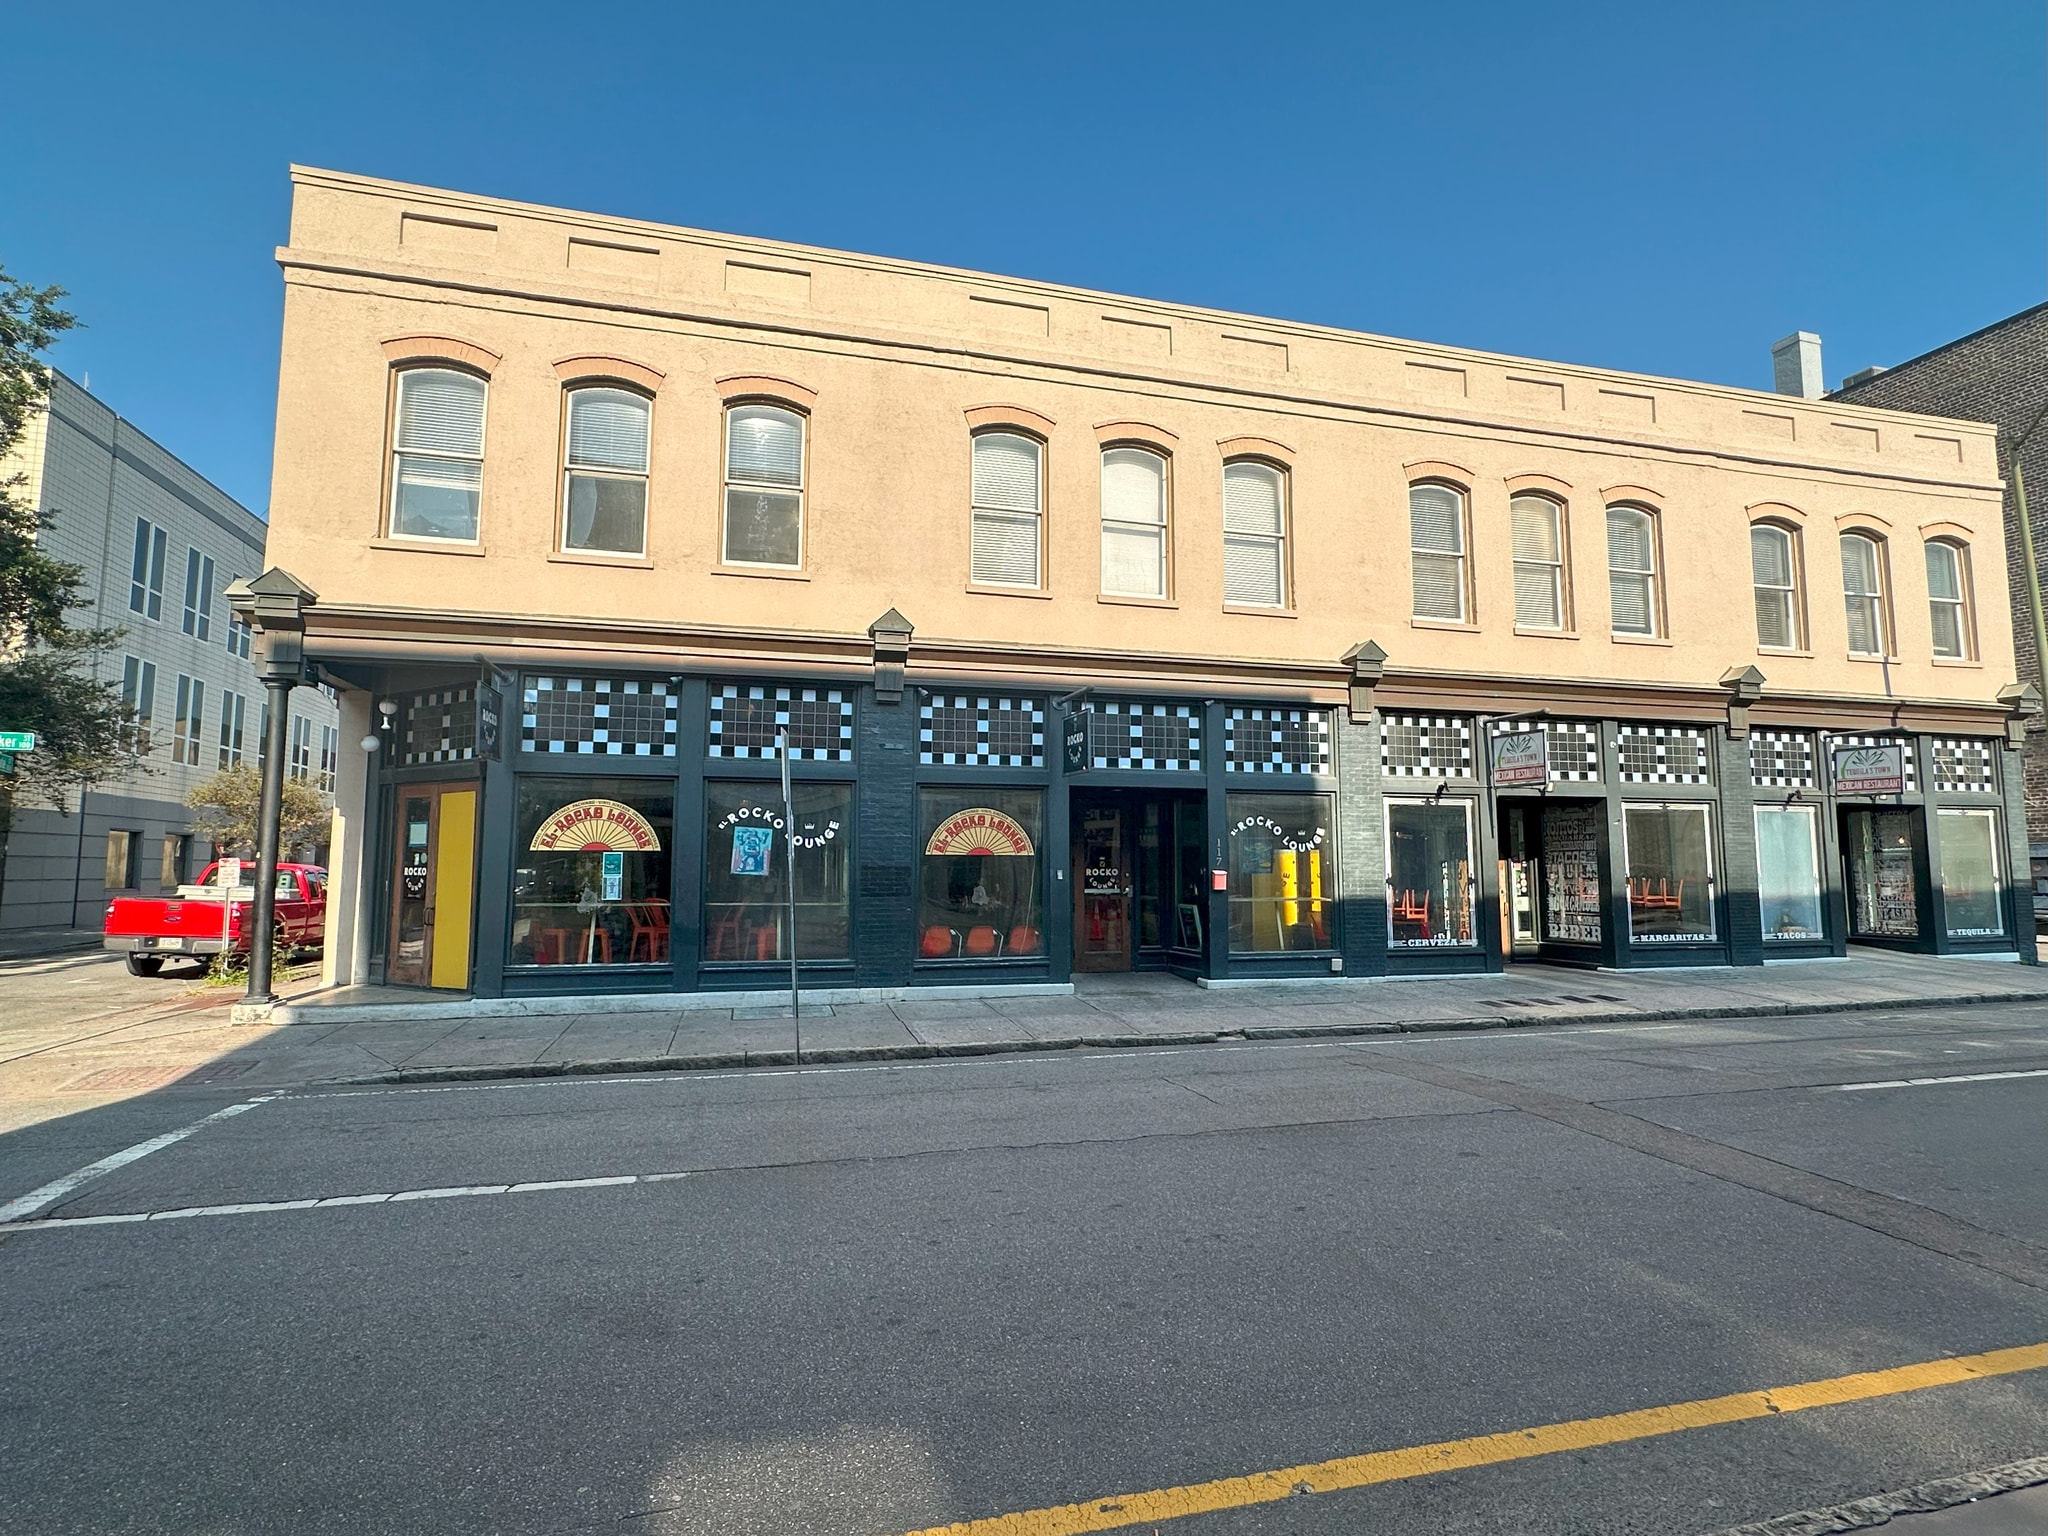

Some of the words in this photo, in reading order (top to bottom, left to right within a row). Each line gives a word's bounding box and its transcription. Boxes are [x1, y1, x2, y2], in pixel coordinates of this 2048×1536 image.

[1874, 766, 1891, 774] TOWN
[1837, 780, 1862, 791] MEXICAN
[1863, 778, 1901, 790] RESTAURANT
[718, 820, 728, 830] EL
[726, 807, 784, 829] ROCKO
[1237, 816, 1282, 836] ROCKO
[1551, 850, 1587, 863] TACOS
[403, 867, 427, 876] ROCKO
[1085, 868, 1119, 876] ROCKO
[1548, 923, 1601, 942] BEBER
[1777, 931, 1807, 939] TACOS
[1956, 928, 1991, 937] TEQUILA
[1640, 933, 1705, 942] MARGARITAS
[1407, 938, 1458, 947] CERVEZA
